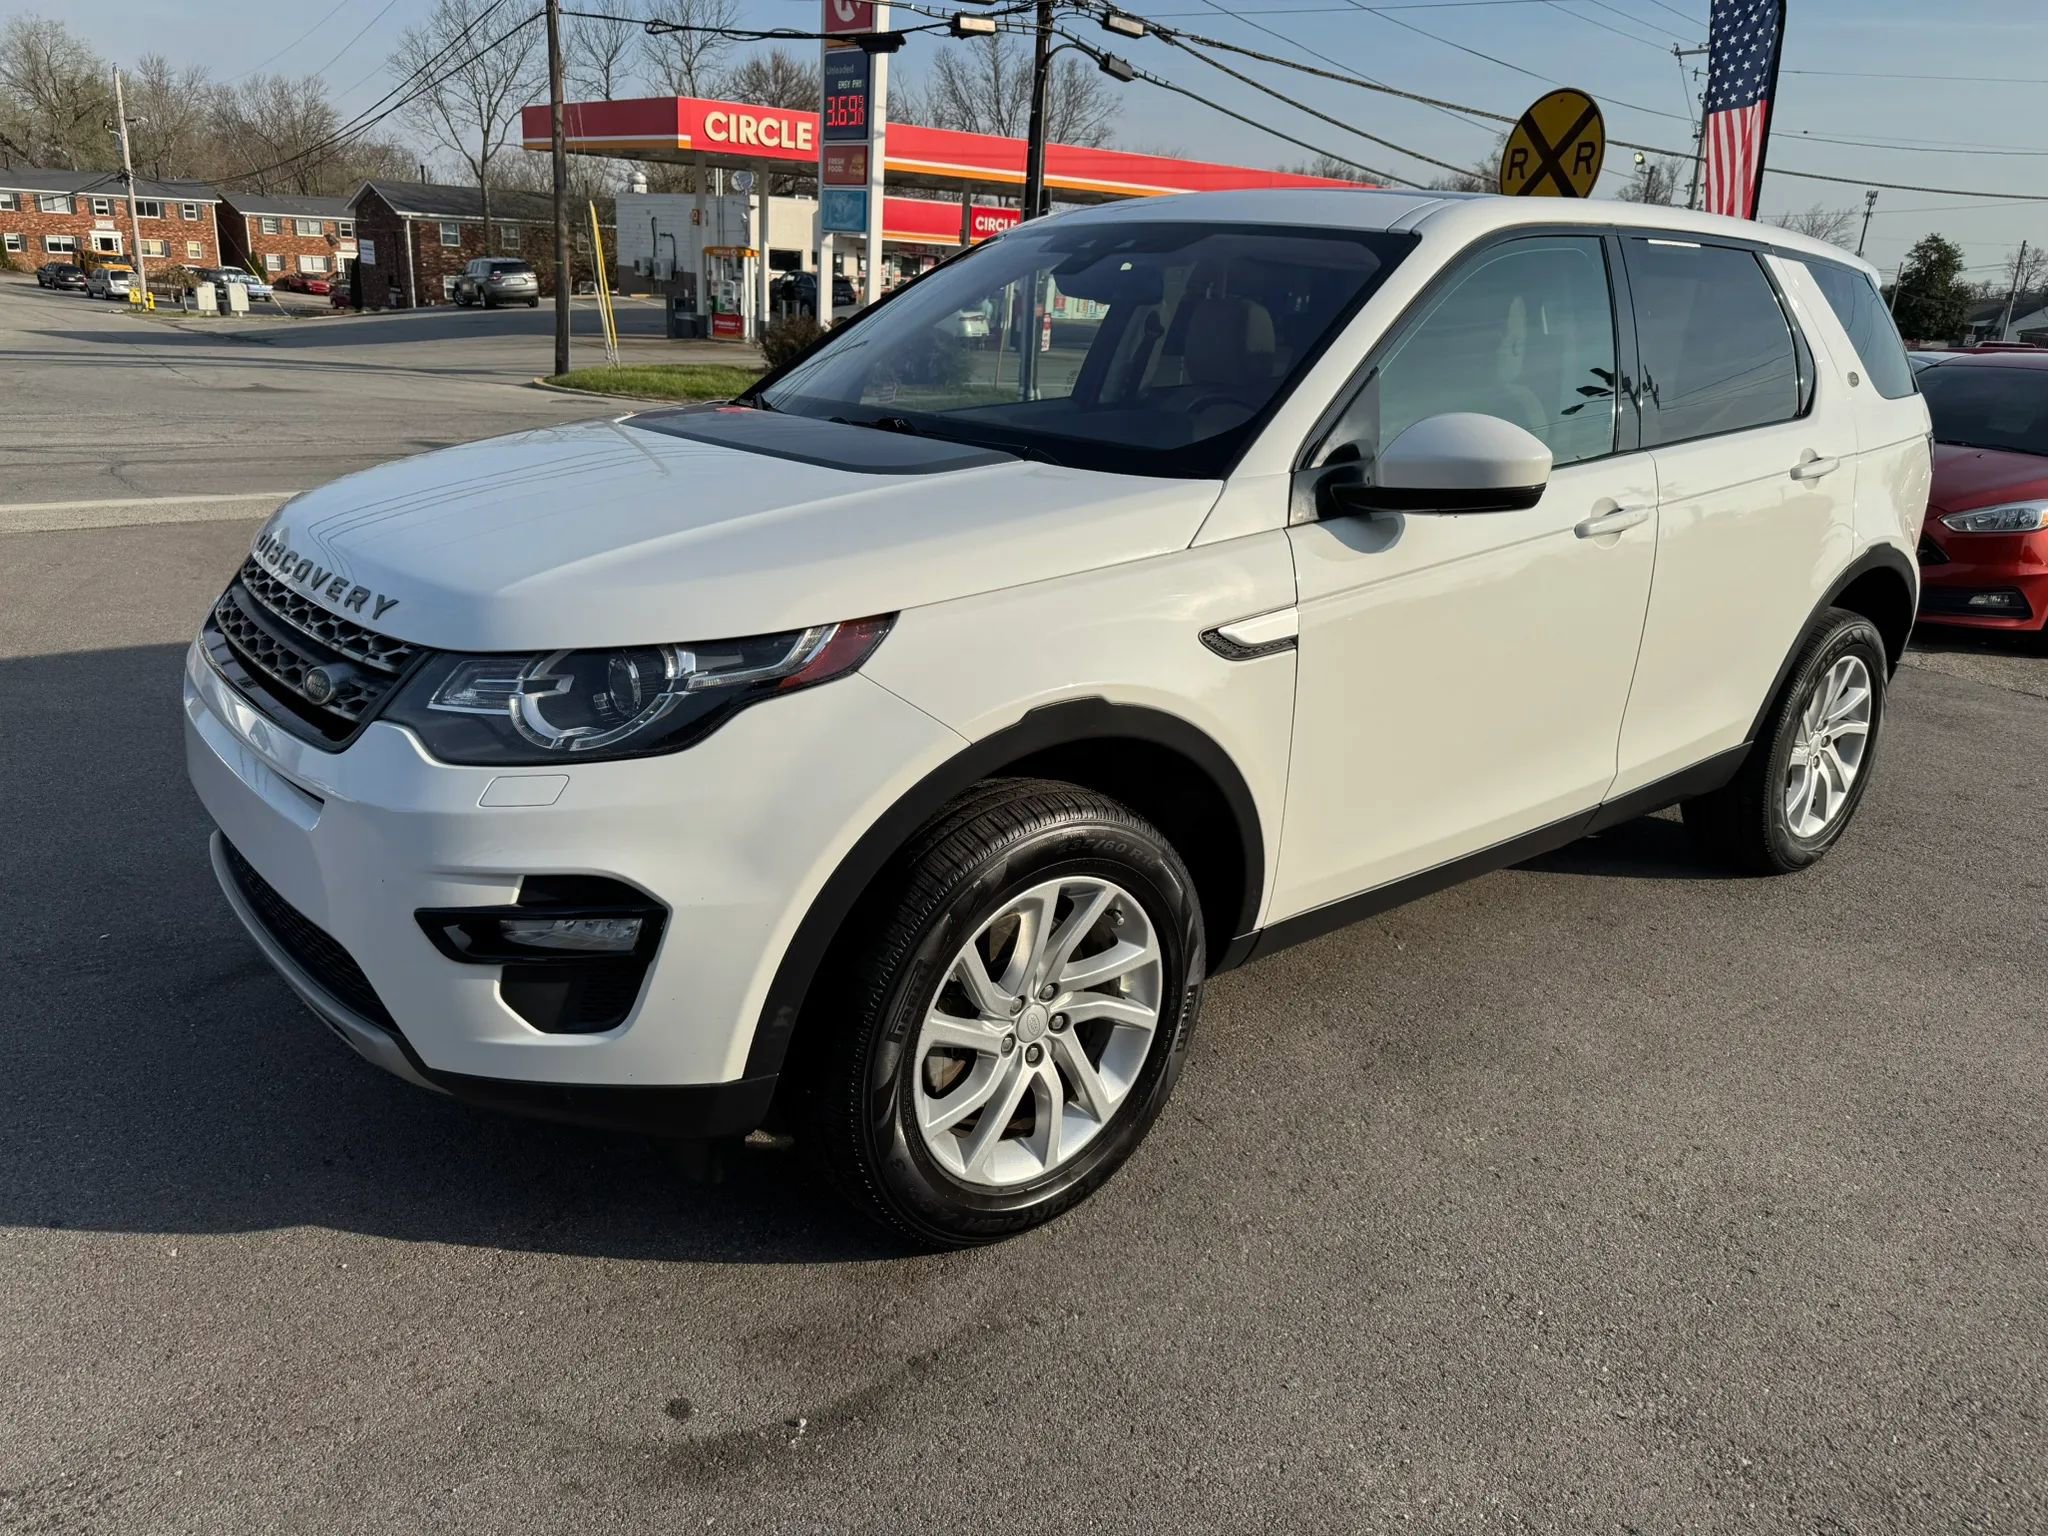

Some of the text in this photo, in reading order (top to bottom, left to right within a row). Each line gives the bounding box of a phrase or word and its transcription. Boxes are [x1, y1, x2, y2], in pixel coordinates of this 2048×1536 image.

[703, 111, 813, 151] CIRCLE
[1507, 141, 1596, 181] R R
[257, 532, 400, 621] DISCOVERY
